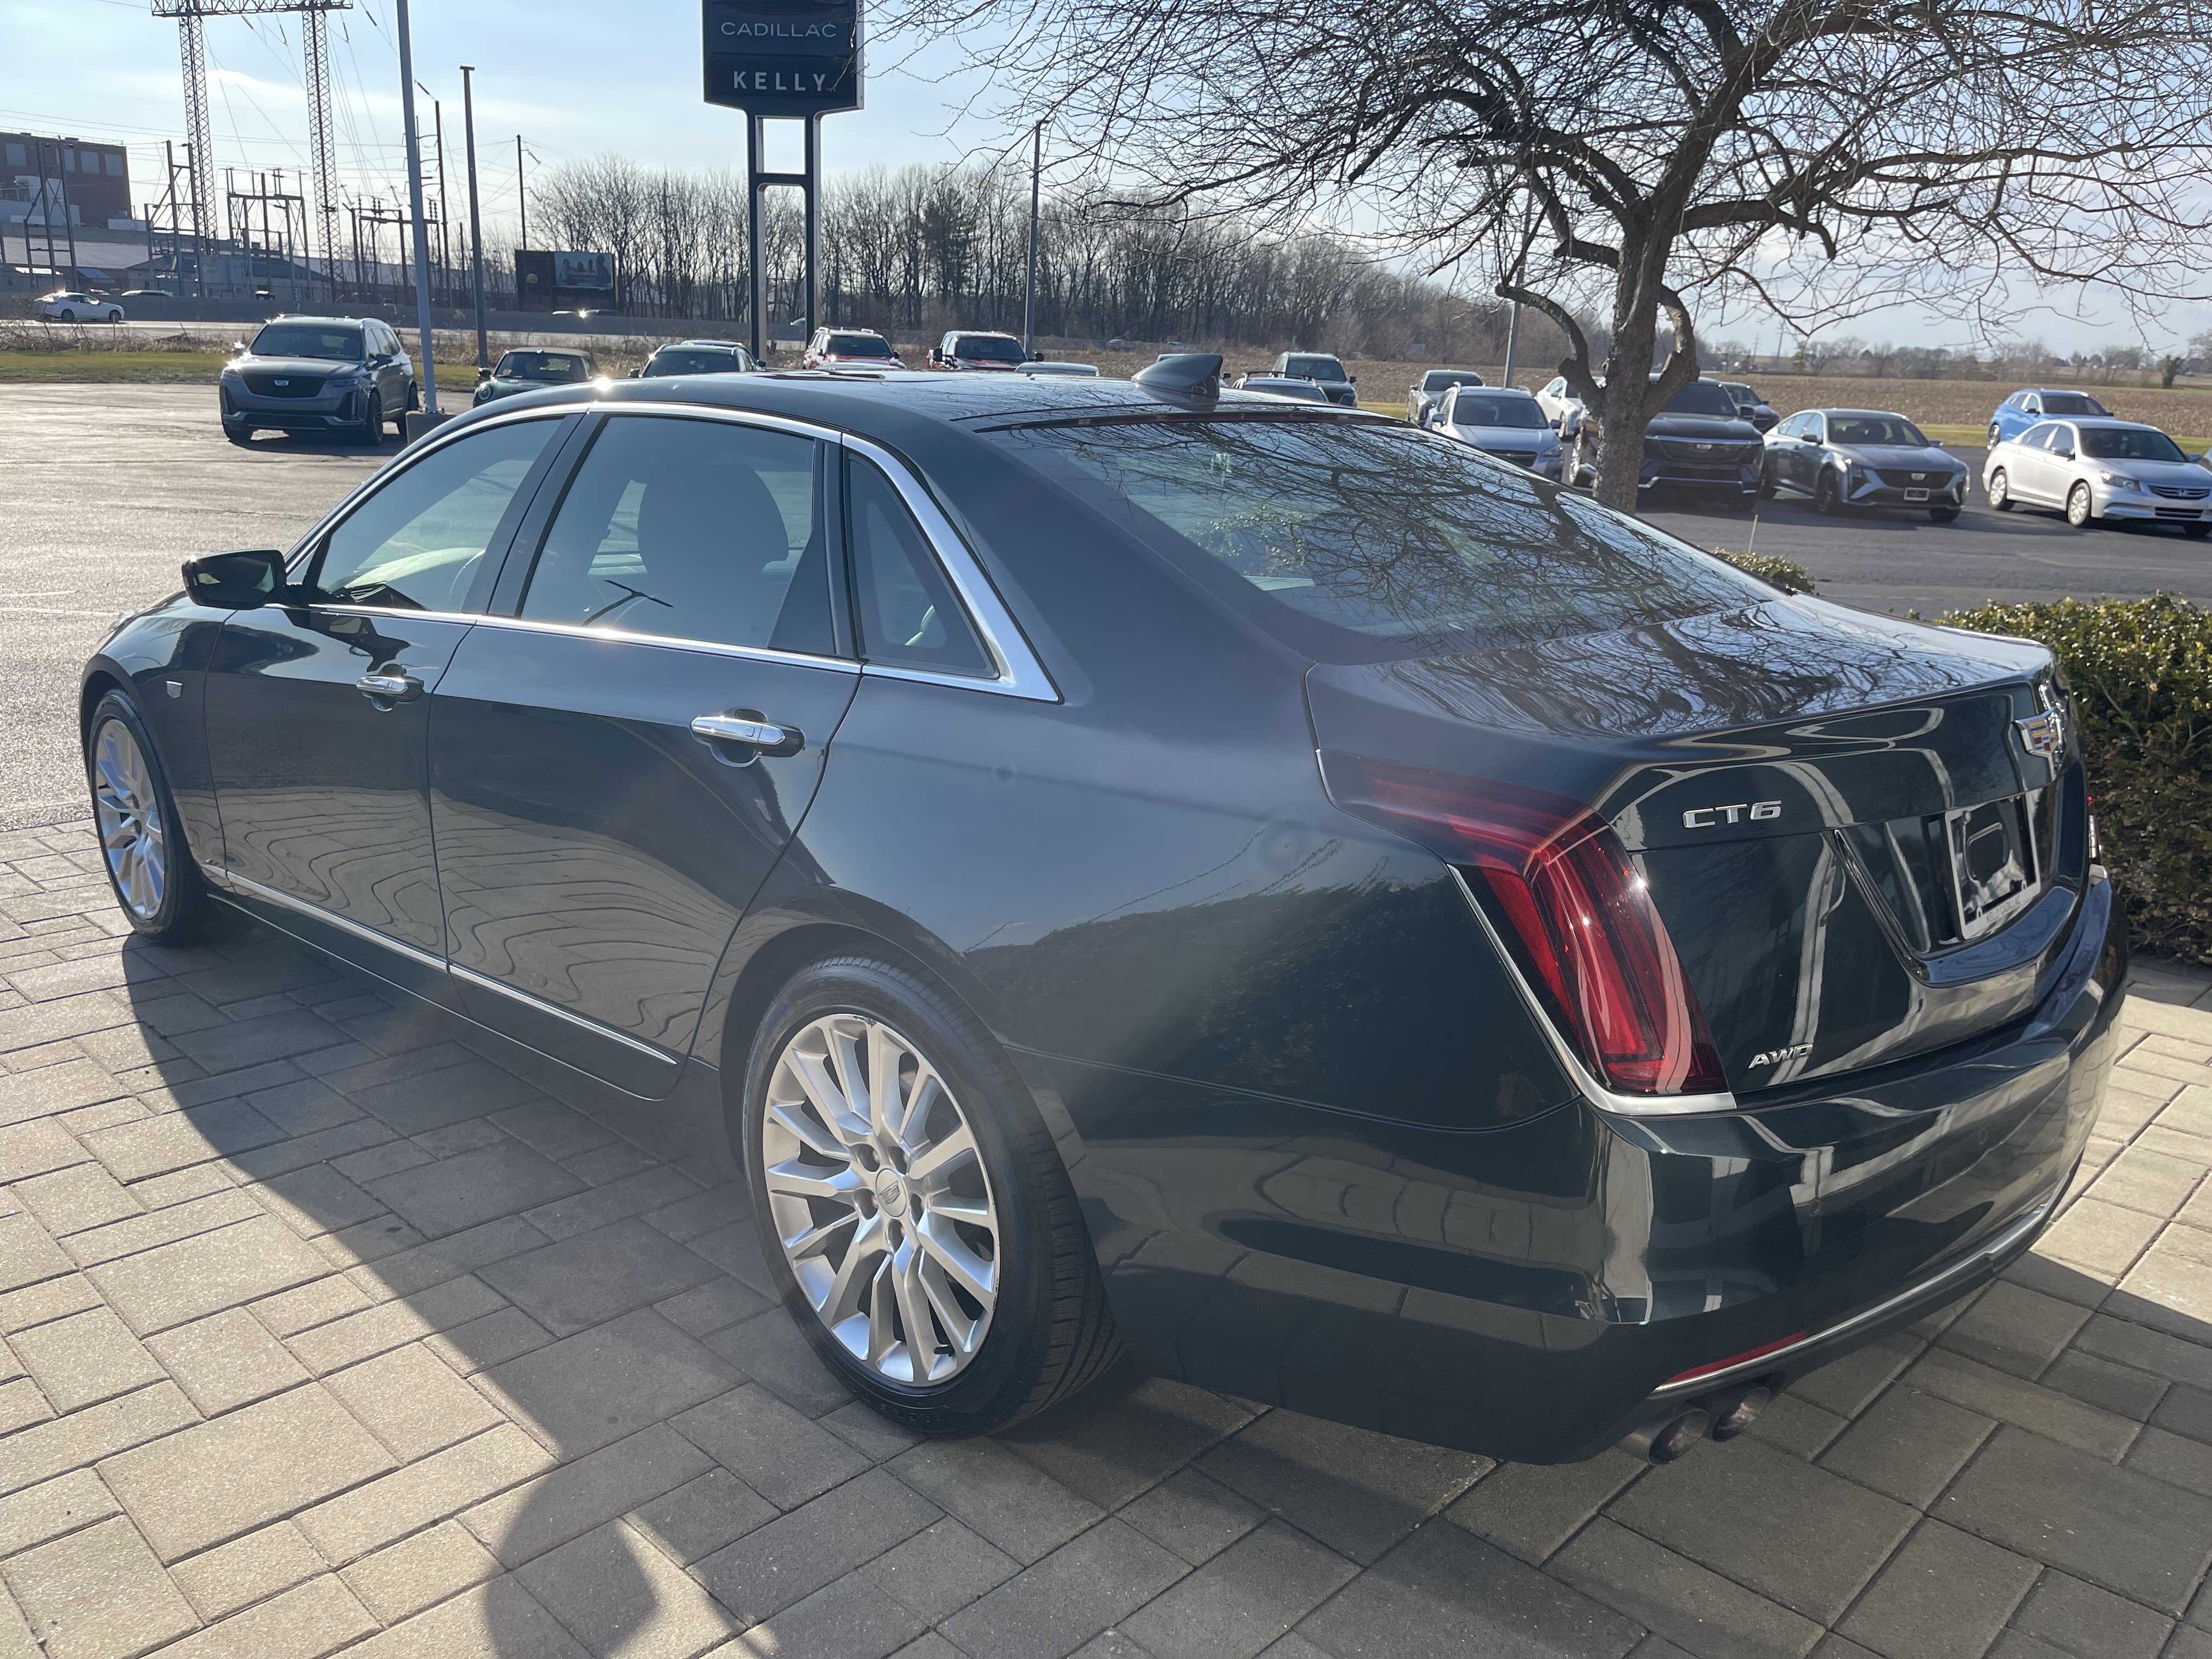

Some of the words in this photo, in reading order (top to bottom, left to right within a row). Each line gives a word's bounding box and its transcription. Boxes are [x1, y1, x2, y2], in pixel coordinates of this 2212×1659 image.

[721, 22, 837, 38] CADILLAC
[733, 70, 827, 92] KELLY
[1683, 800, 1782, 828] CT6
[1748, 1042, 1813, 1069] AWD
